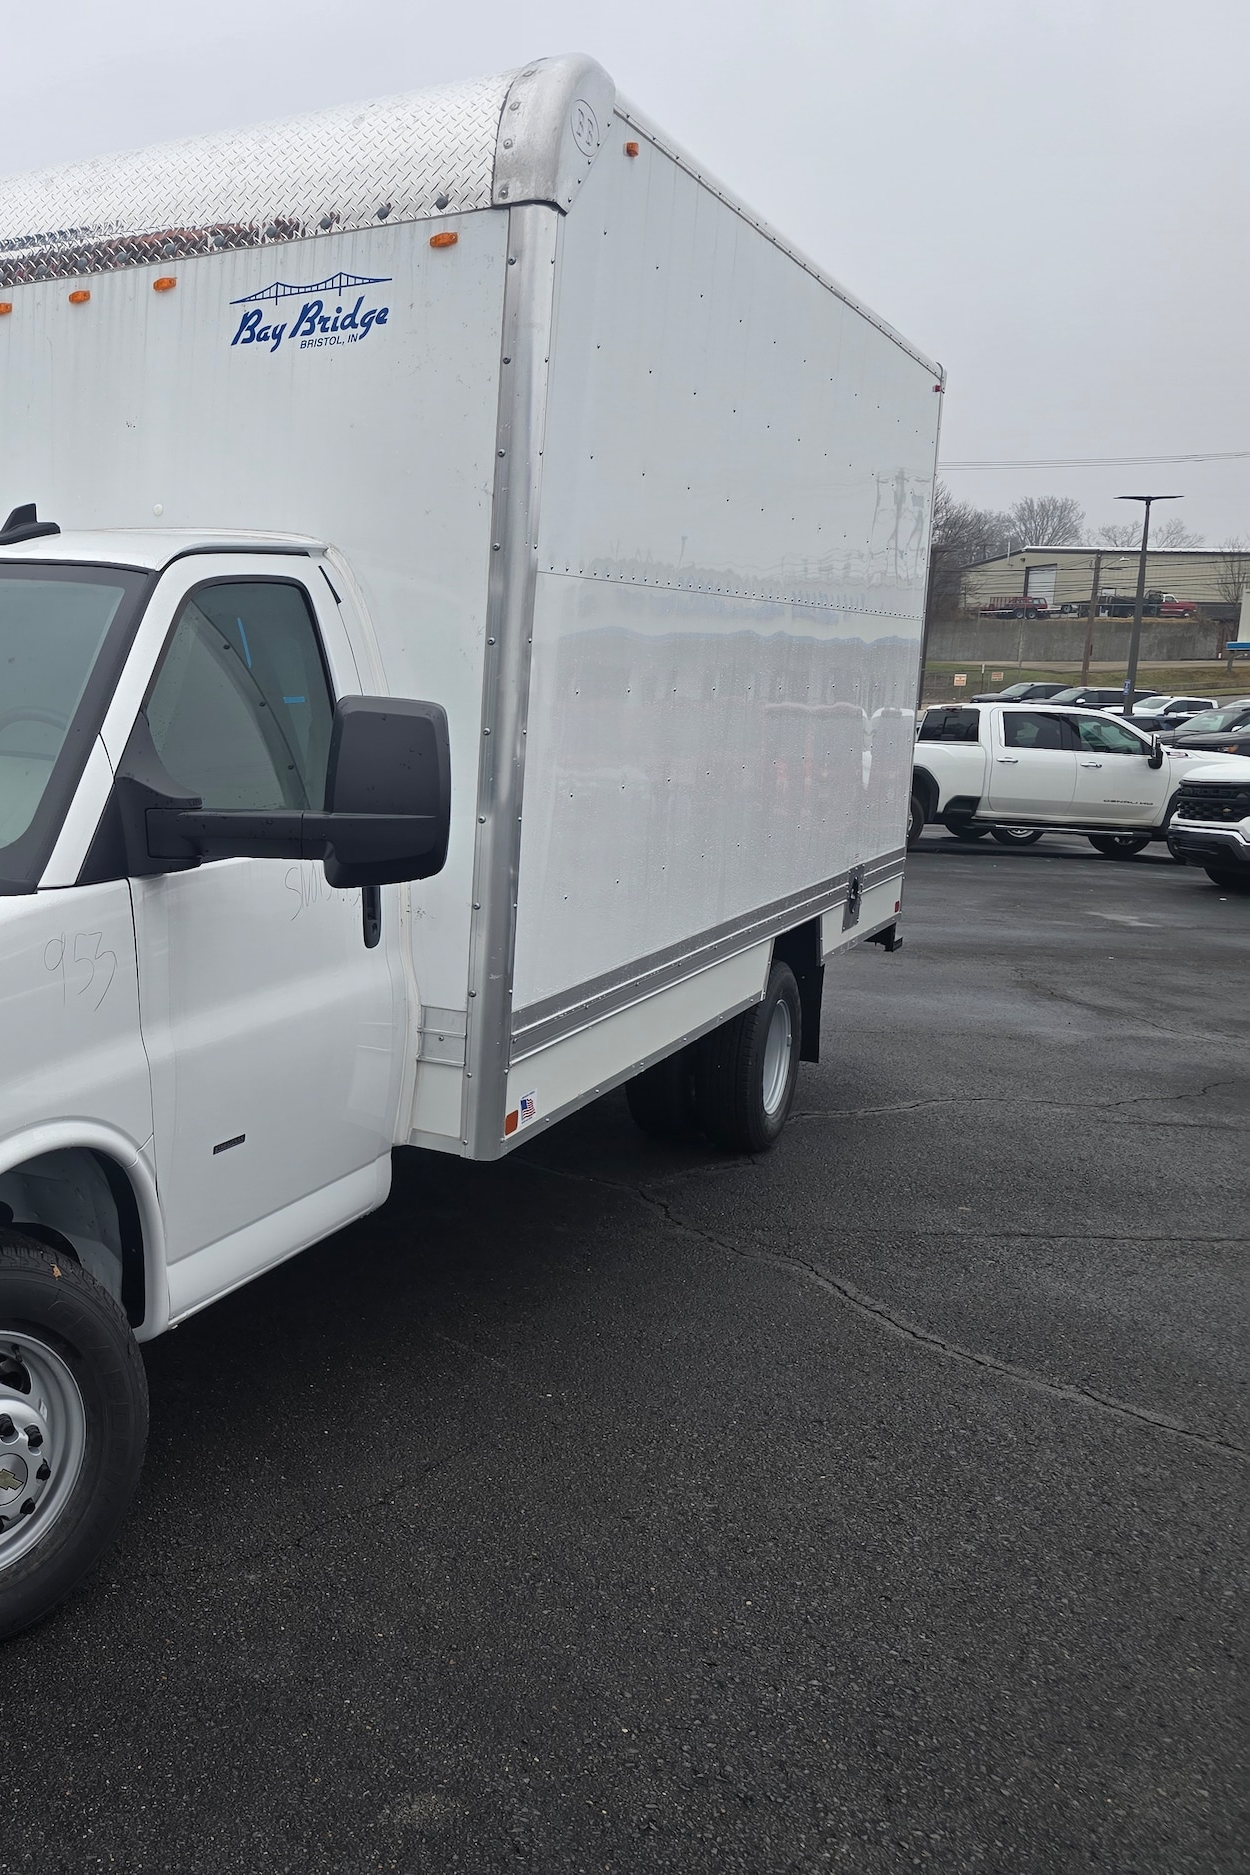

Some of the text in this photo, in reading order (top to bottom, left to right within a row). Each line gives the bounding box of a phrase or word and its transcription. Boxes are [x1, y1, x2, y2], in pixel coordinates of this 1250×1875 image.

[230, 295, 390, 353] Bay Bridge
[300, 333, 359, 349] BRISTOL, IN
[43, 931, 118, 1012] 953
